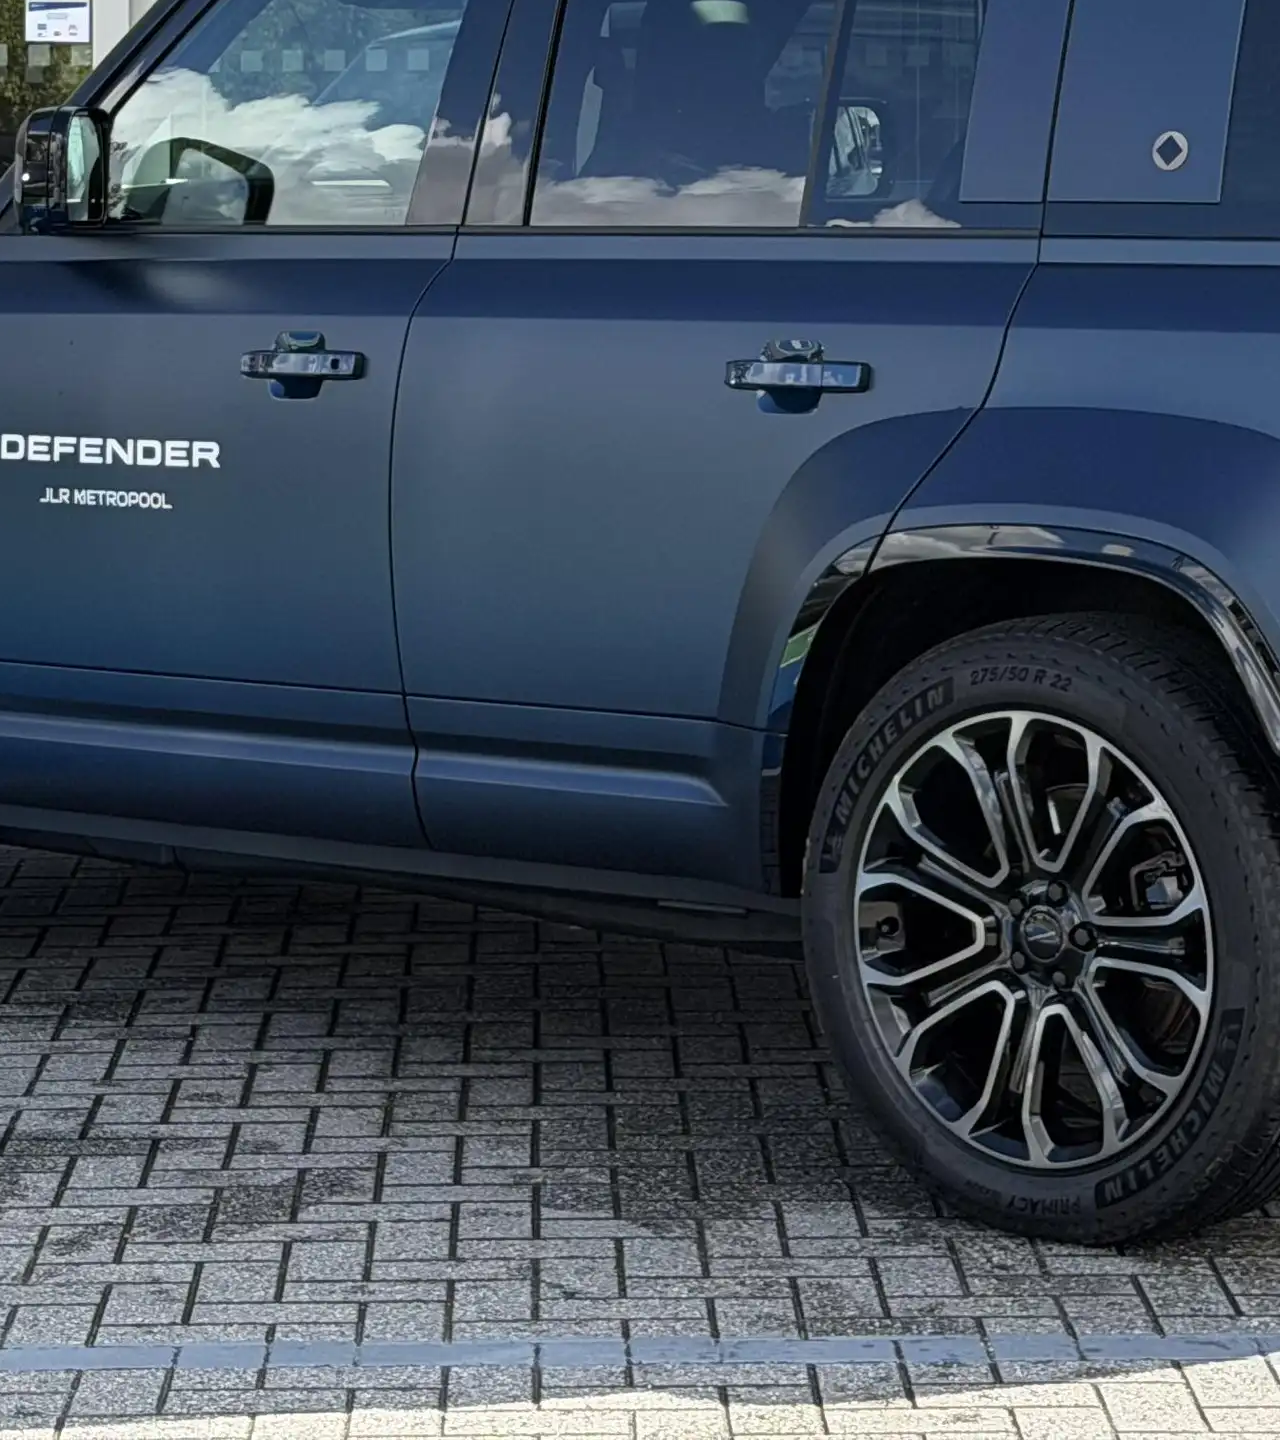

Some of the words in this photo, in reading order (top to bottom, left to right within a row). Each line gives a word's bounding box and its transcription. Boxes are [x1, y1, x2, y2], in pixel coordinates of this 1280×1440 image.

[0, 433, 221, 469] DEFENDER
[39, 487, 70, 504] JLR
[74, 489, 173, 510] METROPOOL
[970, 665, 1029, 686] 275/50
[1033, 668, 1048, 684] R
[1049, 673, 1072, 692] 22
[835, 684, 945, 825] MICHELIN
[1103, 1060, 1226, 1202] MICHELIN
